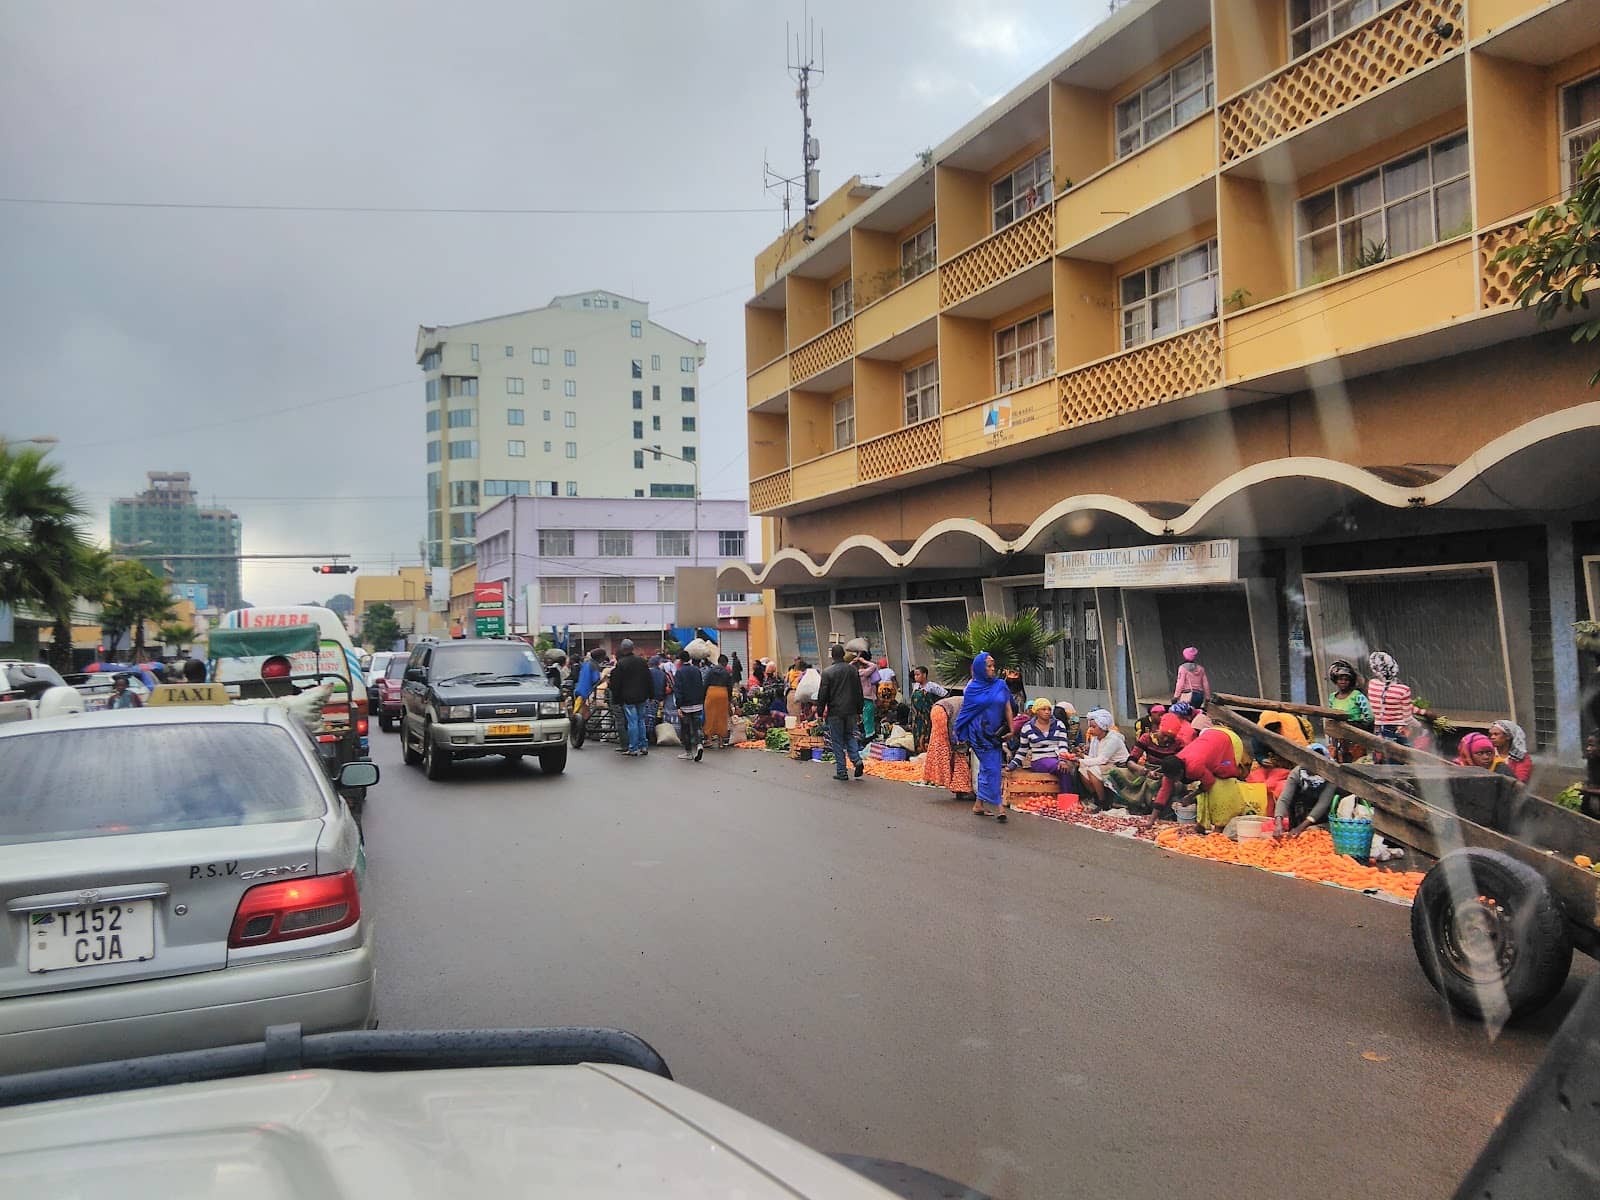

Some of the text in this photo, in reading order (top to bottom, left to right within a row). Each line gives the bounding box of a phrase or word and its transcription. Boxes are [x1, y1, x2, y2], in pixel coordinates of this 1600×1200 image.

[1089, 550, 1134, 567] CHEMICAL
[1137, 546, 1195, 564] INDUSTRIES
[164, 687, 214, 702] TAXI
[57, 905, 122, 937] T152
[75, 934, 123, 963] CJA
